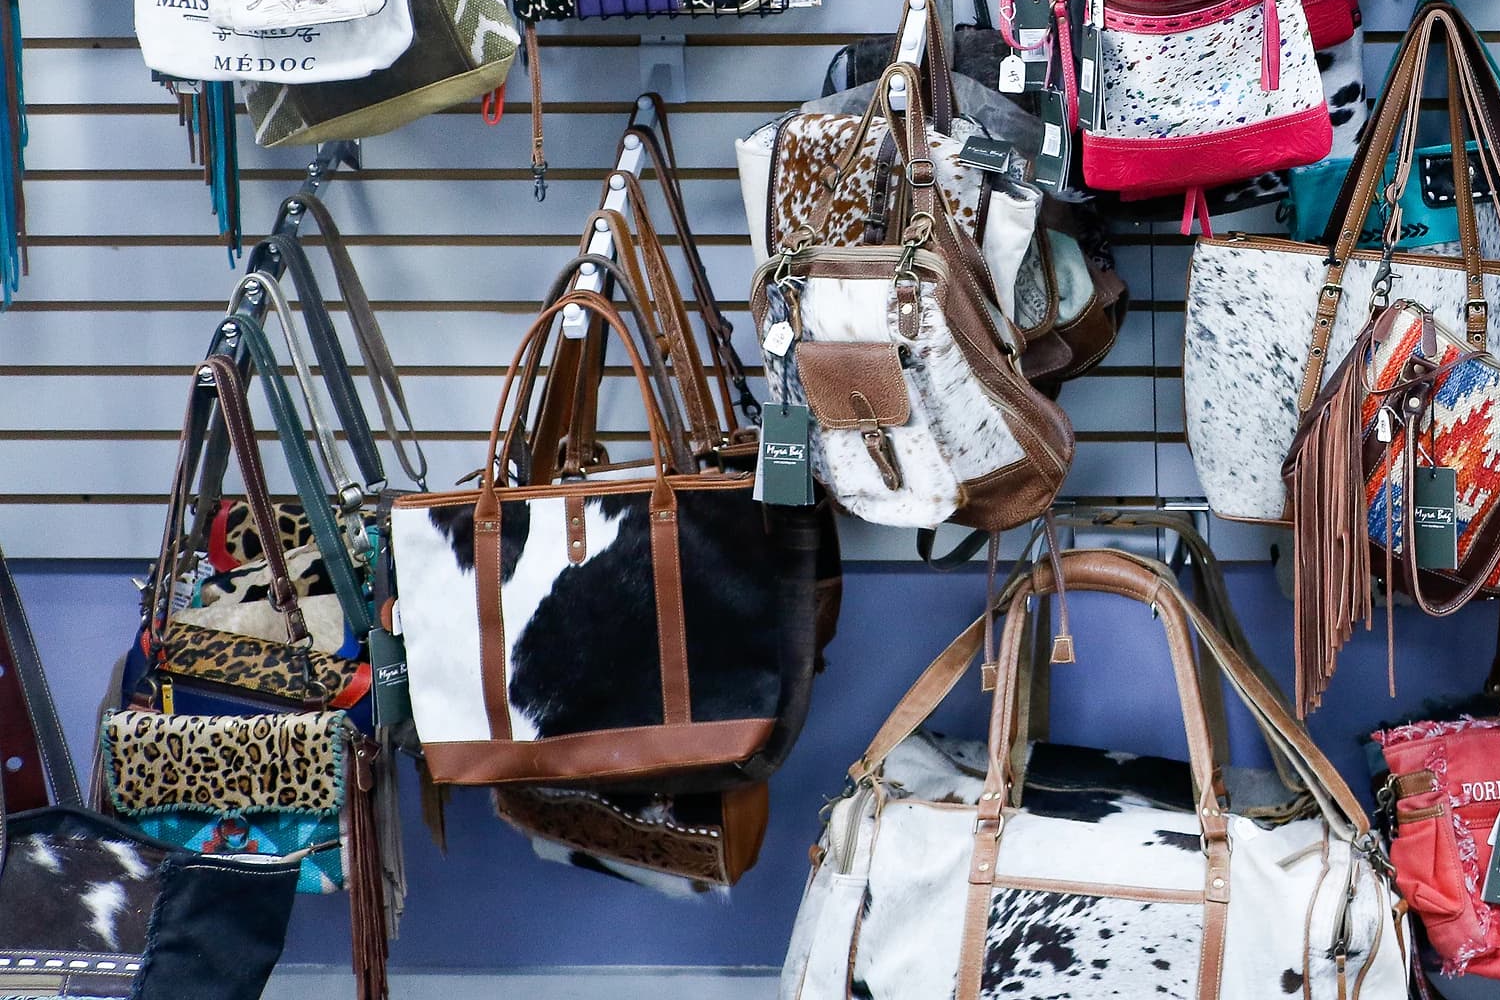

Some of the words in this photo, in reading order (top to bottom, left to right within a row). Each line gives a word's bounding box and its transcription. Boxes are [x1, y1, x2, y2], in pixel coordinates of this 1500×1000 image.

[213, 53, 317, 72] MÉDOC
[766, 444, 787, 458] Myra
[789, 445, 804, 459] Bag
[1415, 508, 1435, 521] Myra
[1437, 509, 1452, 523] Bag
